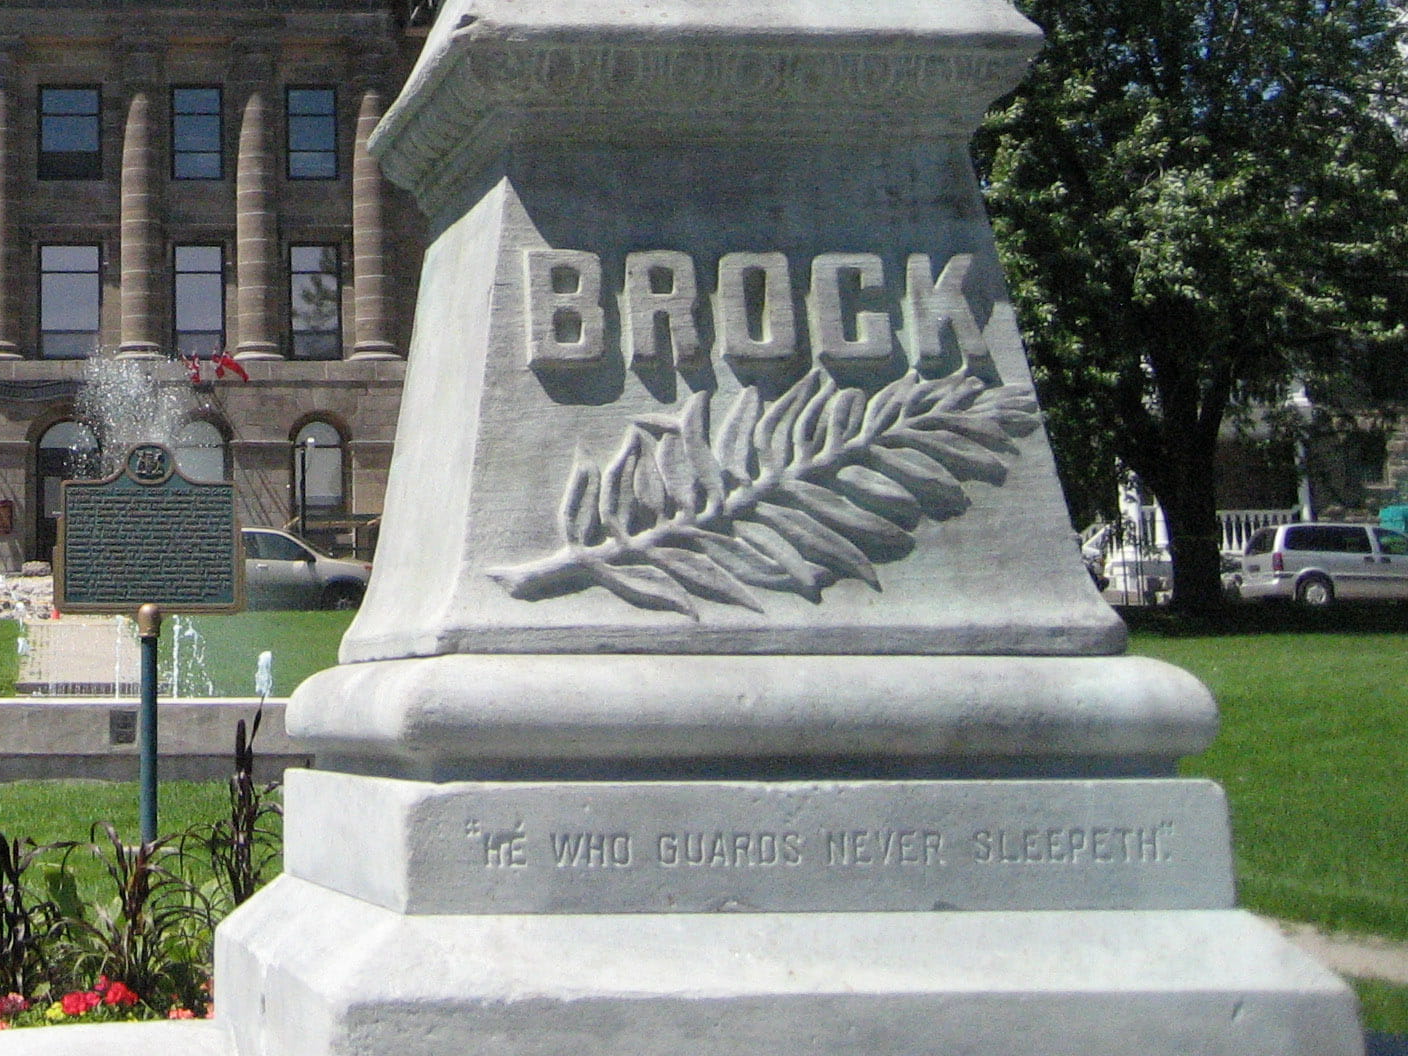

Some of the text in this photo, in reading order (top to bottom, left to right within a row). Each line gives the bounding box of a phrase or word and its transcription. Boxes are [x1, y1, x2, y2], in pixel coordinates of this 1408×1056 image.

[524, 248, 992, 364] BROCK
[549, 830, 633, 867] WHO
[658, 831, 805, 867] GUARDS
[826, 828, 946, 866] NEVER
